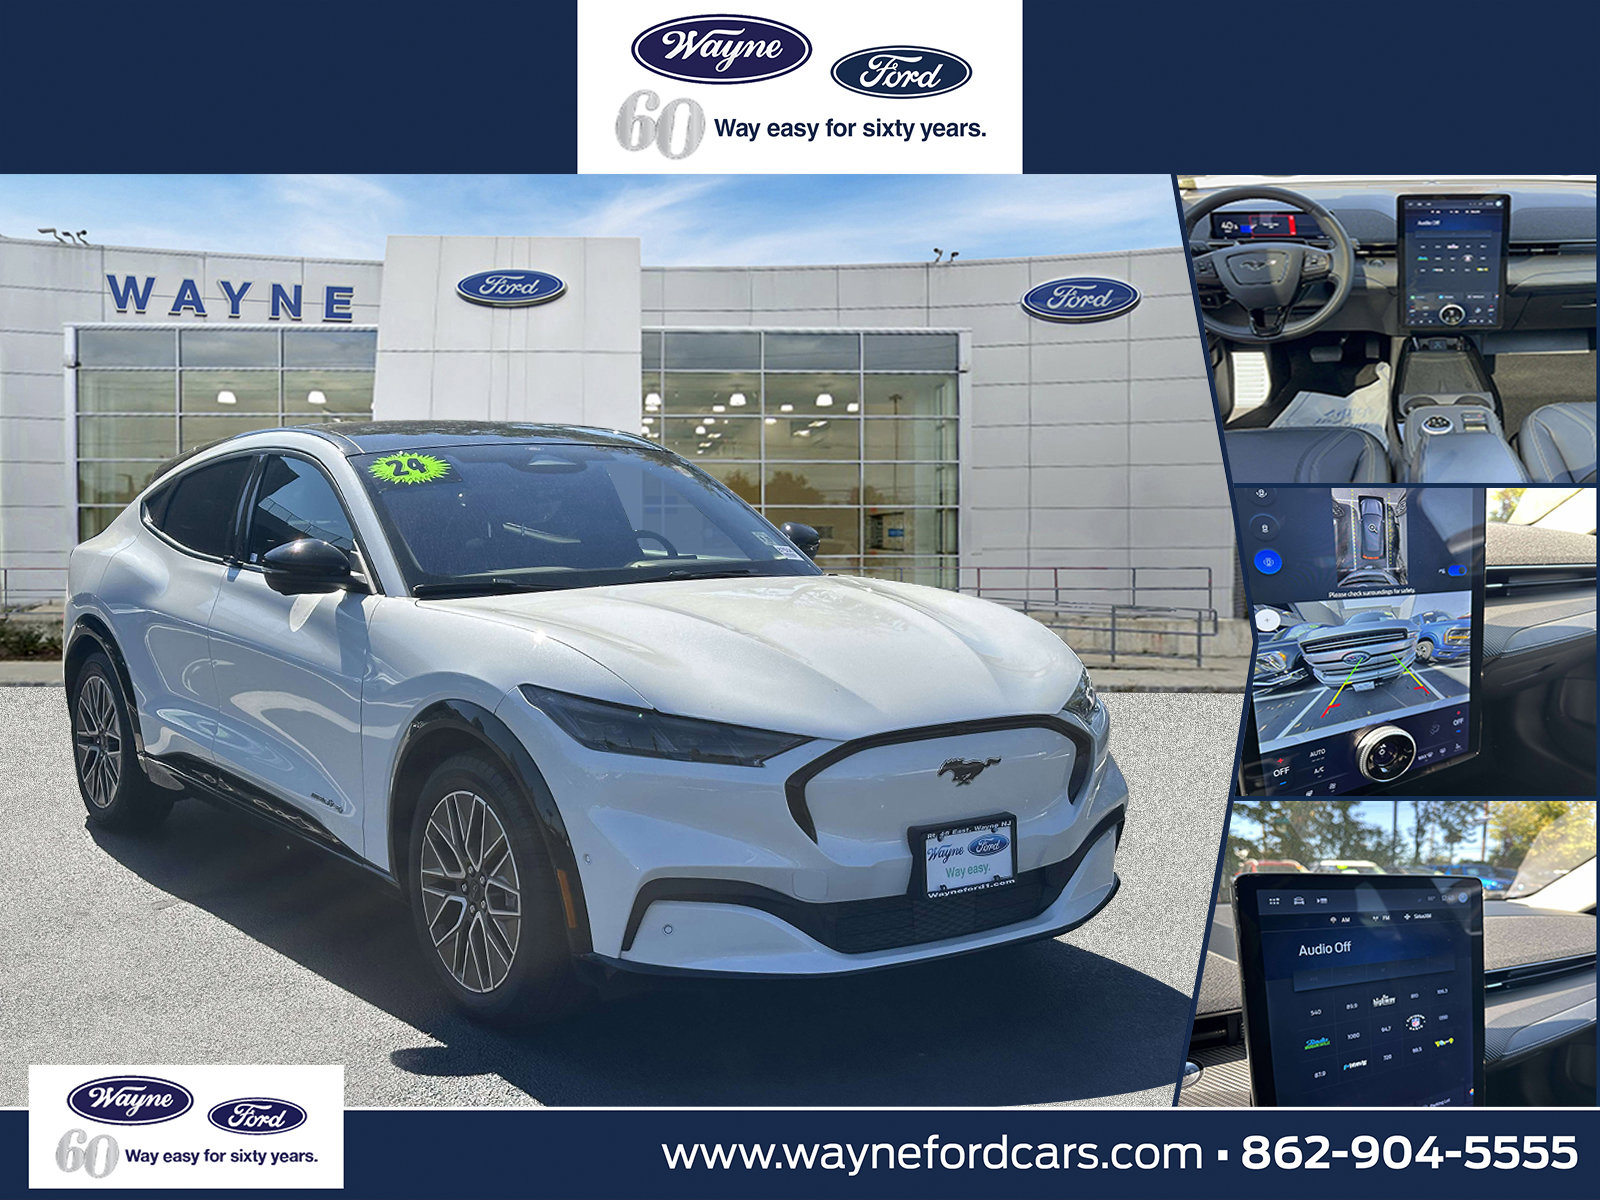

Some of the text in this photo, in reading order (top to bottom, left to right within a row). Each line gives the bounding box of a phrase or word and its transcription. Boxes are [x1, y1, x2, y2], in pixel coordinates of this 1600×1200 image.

[479, 275, 540, 295] Ford
[105, 274, 355, 321] WAYNE
[1046, 285, 1114, 309] Ford
[1273, 765, 1290, 777] OFF
[927, 837, 1001, 864] Wayne Ford
[945, 863, 991, 879] Way easy.
[1298, 940, 1352, 957] Audio Off
